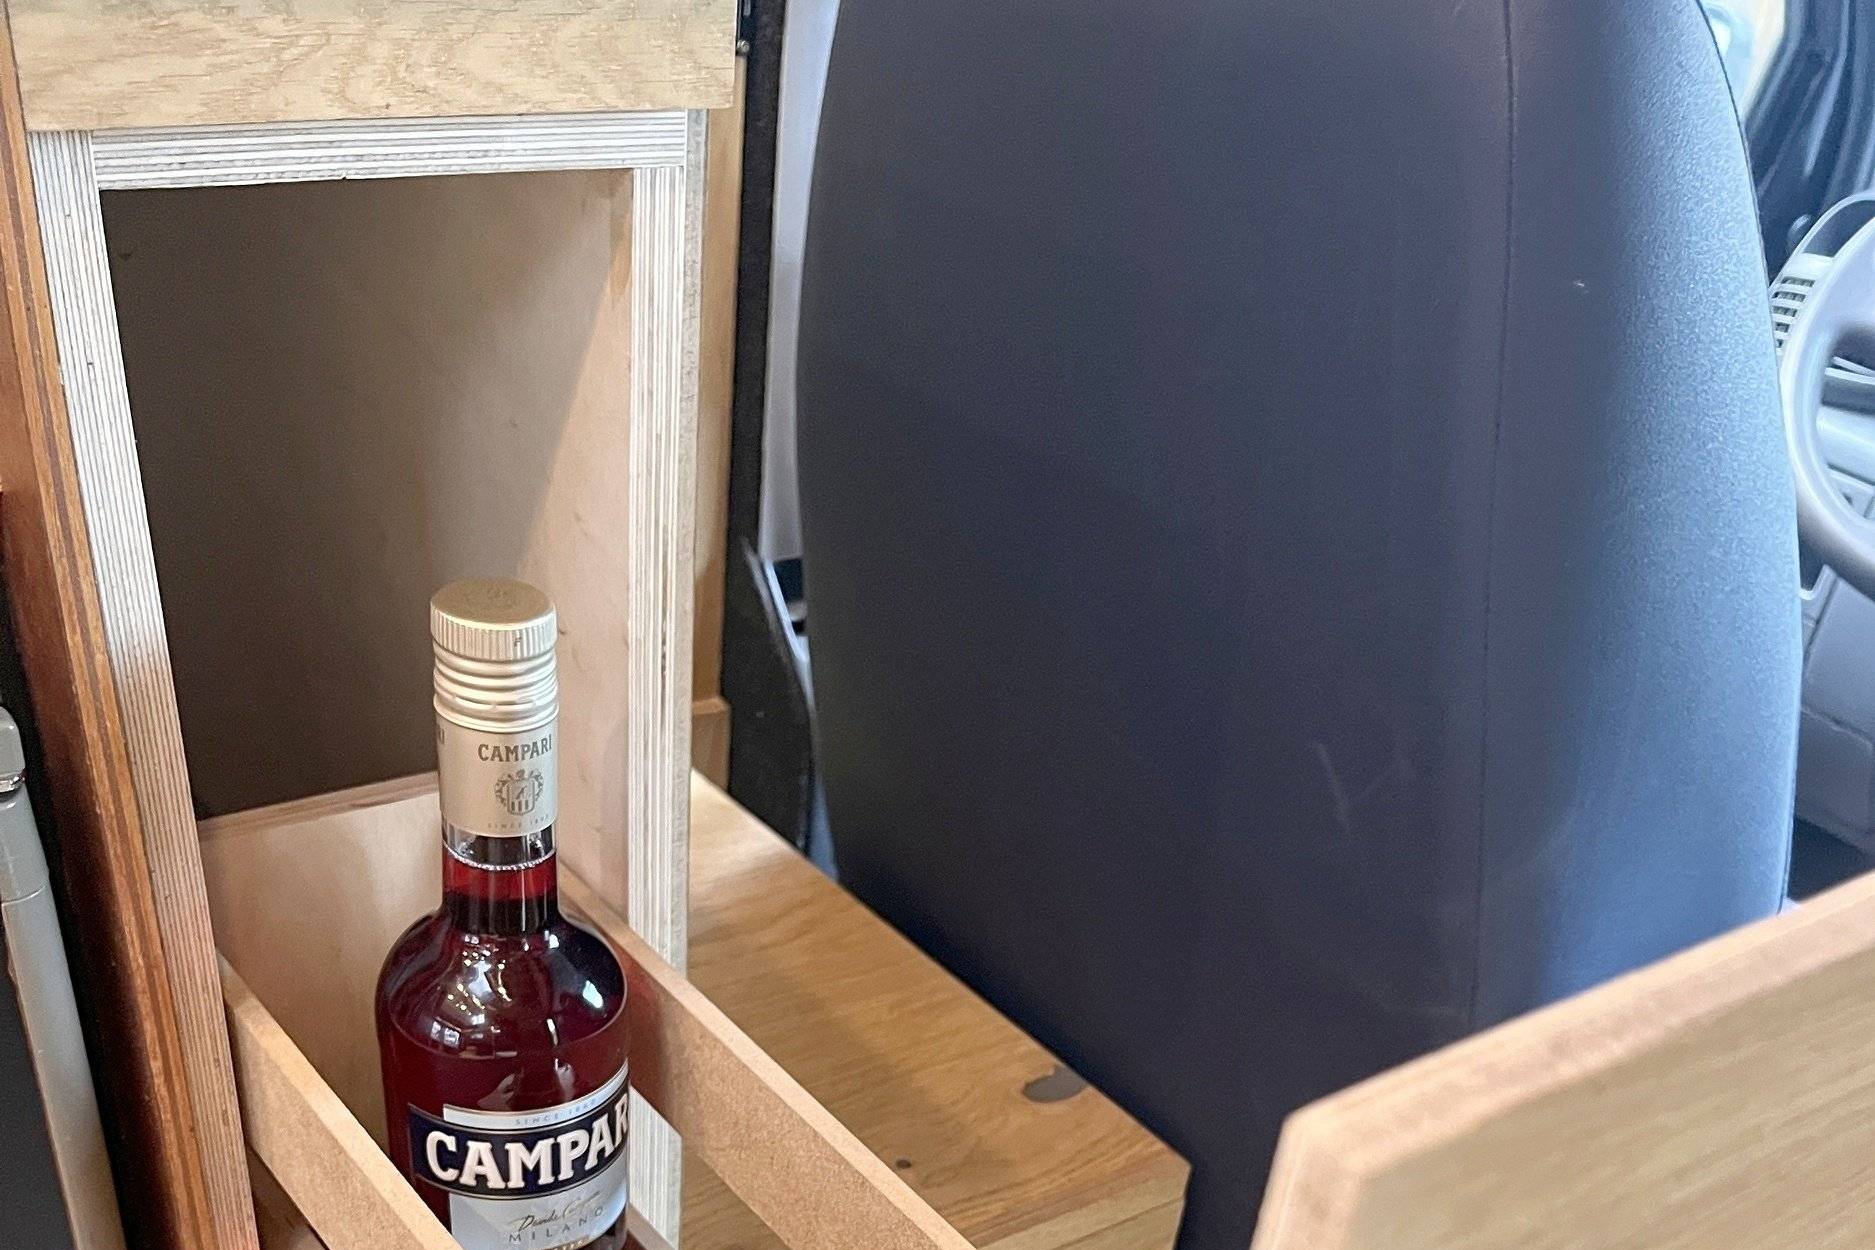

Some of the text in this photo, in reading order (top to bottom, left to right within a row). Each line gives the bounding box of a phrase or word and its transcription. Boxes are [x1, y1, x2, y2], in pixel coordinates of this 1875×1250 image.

[477, 734, 552, 762] CAMPARI
[426, 1092, 628, 1190] CAMPAR
[509, 1206, 603, 1242] MILANO
